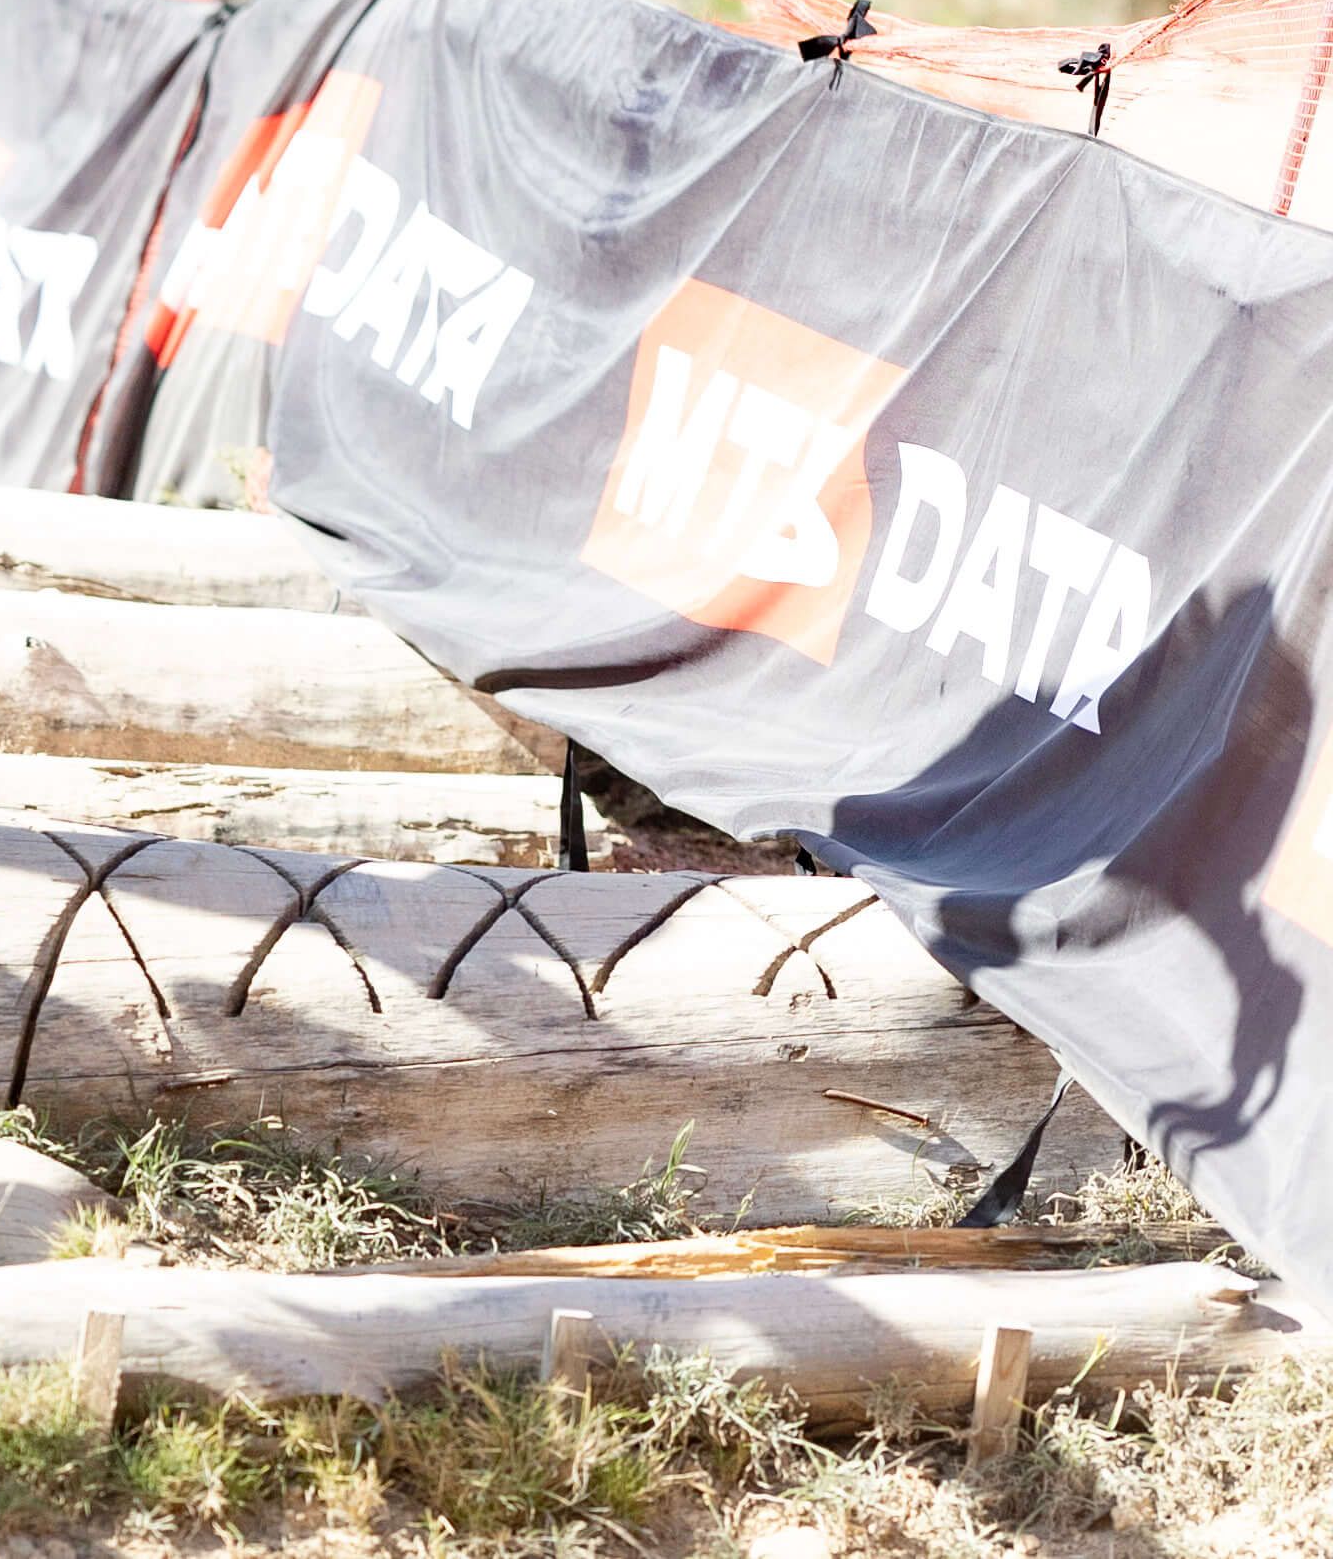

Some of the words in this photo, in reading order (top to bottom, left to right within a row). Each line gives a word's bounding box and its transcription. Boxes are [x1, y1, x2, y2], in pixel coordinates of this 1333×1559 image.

[302, 153, 535, 430] DATA
[614, 345, 840, 589] MTB
[864, 441, 1152, 735] DATA
